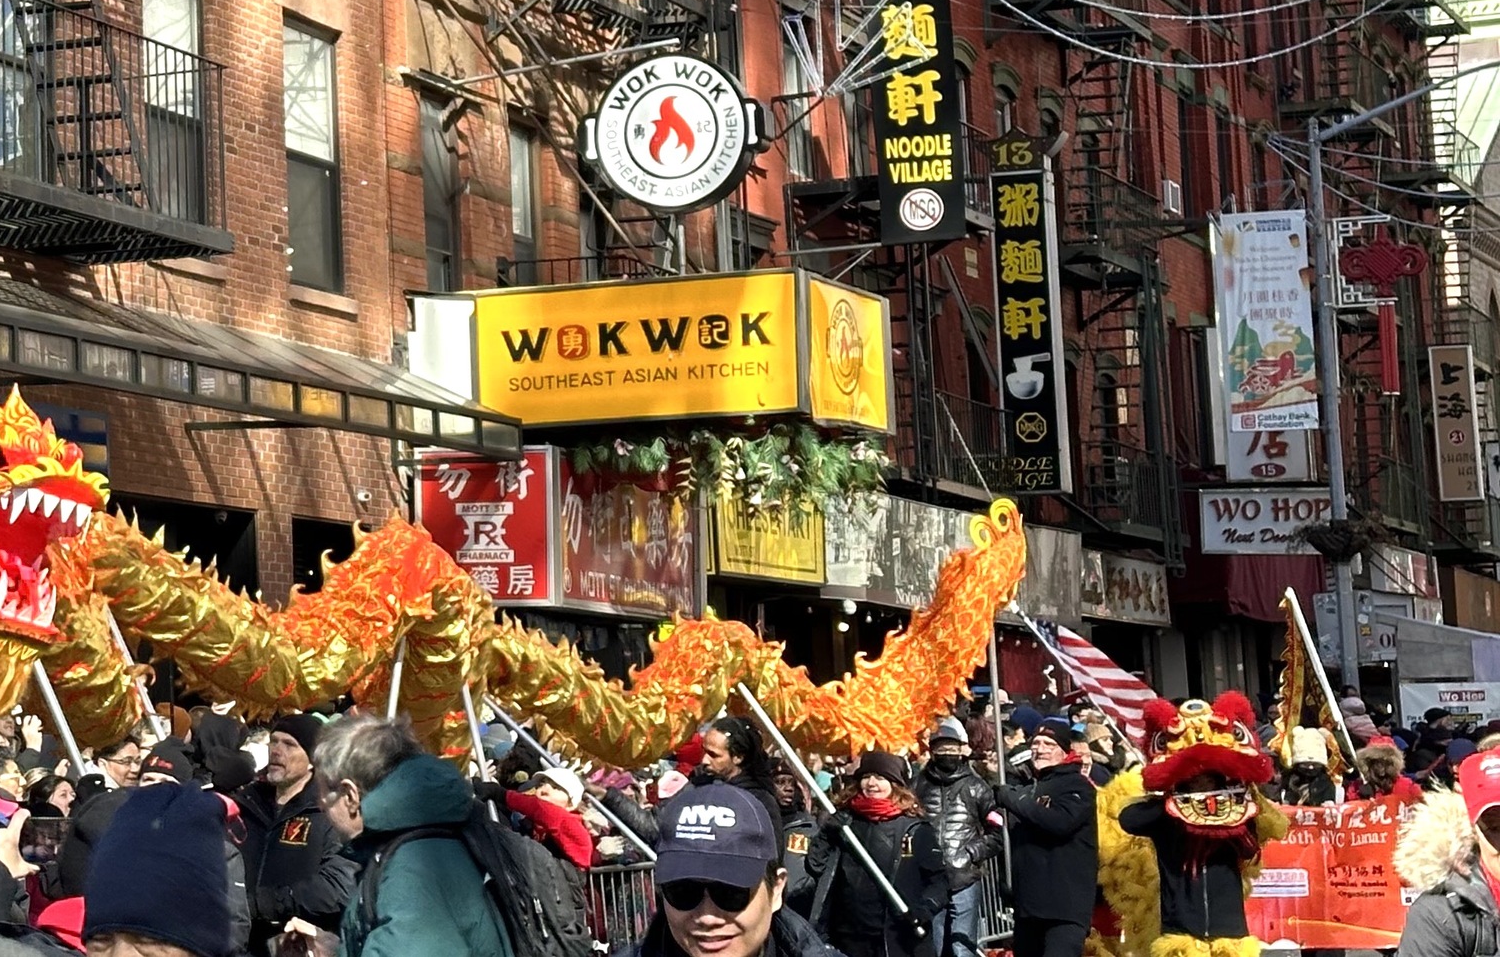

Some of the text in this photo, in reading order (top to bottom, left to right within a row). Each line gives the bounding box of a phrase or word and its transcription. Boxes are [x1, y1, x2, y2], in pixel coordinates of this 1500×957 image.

[609, 61, 729, 111] WOK WOK
[606, 106, 738, 197] SOUTHEAST ASIAN KITCHEN
[885, 134, 952, 159] NOODLE
[993, 141, 1034, 166] 13
[889, 159, 953, 184] VILLAGE
[909, 198, 936, 221] MSG
[997, 182, 1047, 340] 粥麵軒
[508, 361, 770, 393] SOUTHEAST ASIAN KITCHEN
[1437, 362, 1472, 420] 上海
[1257, 413, 1287, 422] Cathay
[1257, 420, 1305, 429] Foundation
[1451, 432, 1463, 442] 21
[434, 459, 535, 500] 勿街
[1260, 465, 1276, 476] 15
[461, 504, 506, 513] MOTT ST
[1208, 497, 1331, 523] WO HOP
[458, 551, 510, 561] PHARMACY
[580, 570, 606, 599] MOTT
[678, 804, 736, 828] NYC
[1321, 829, 1346, 848] NYC
[1351, 831, 1389, 847] Lunar
